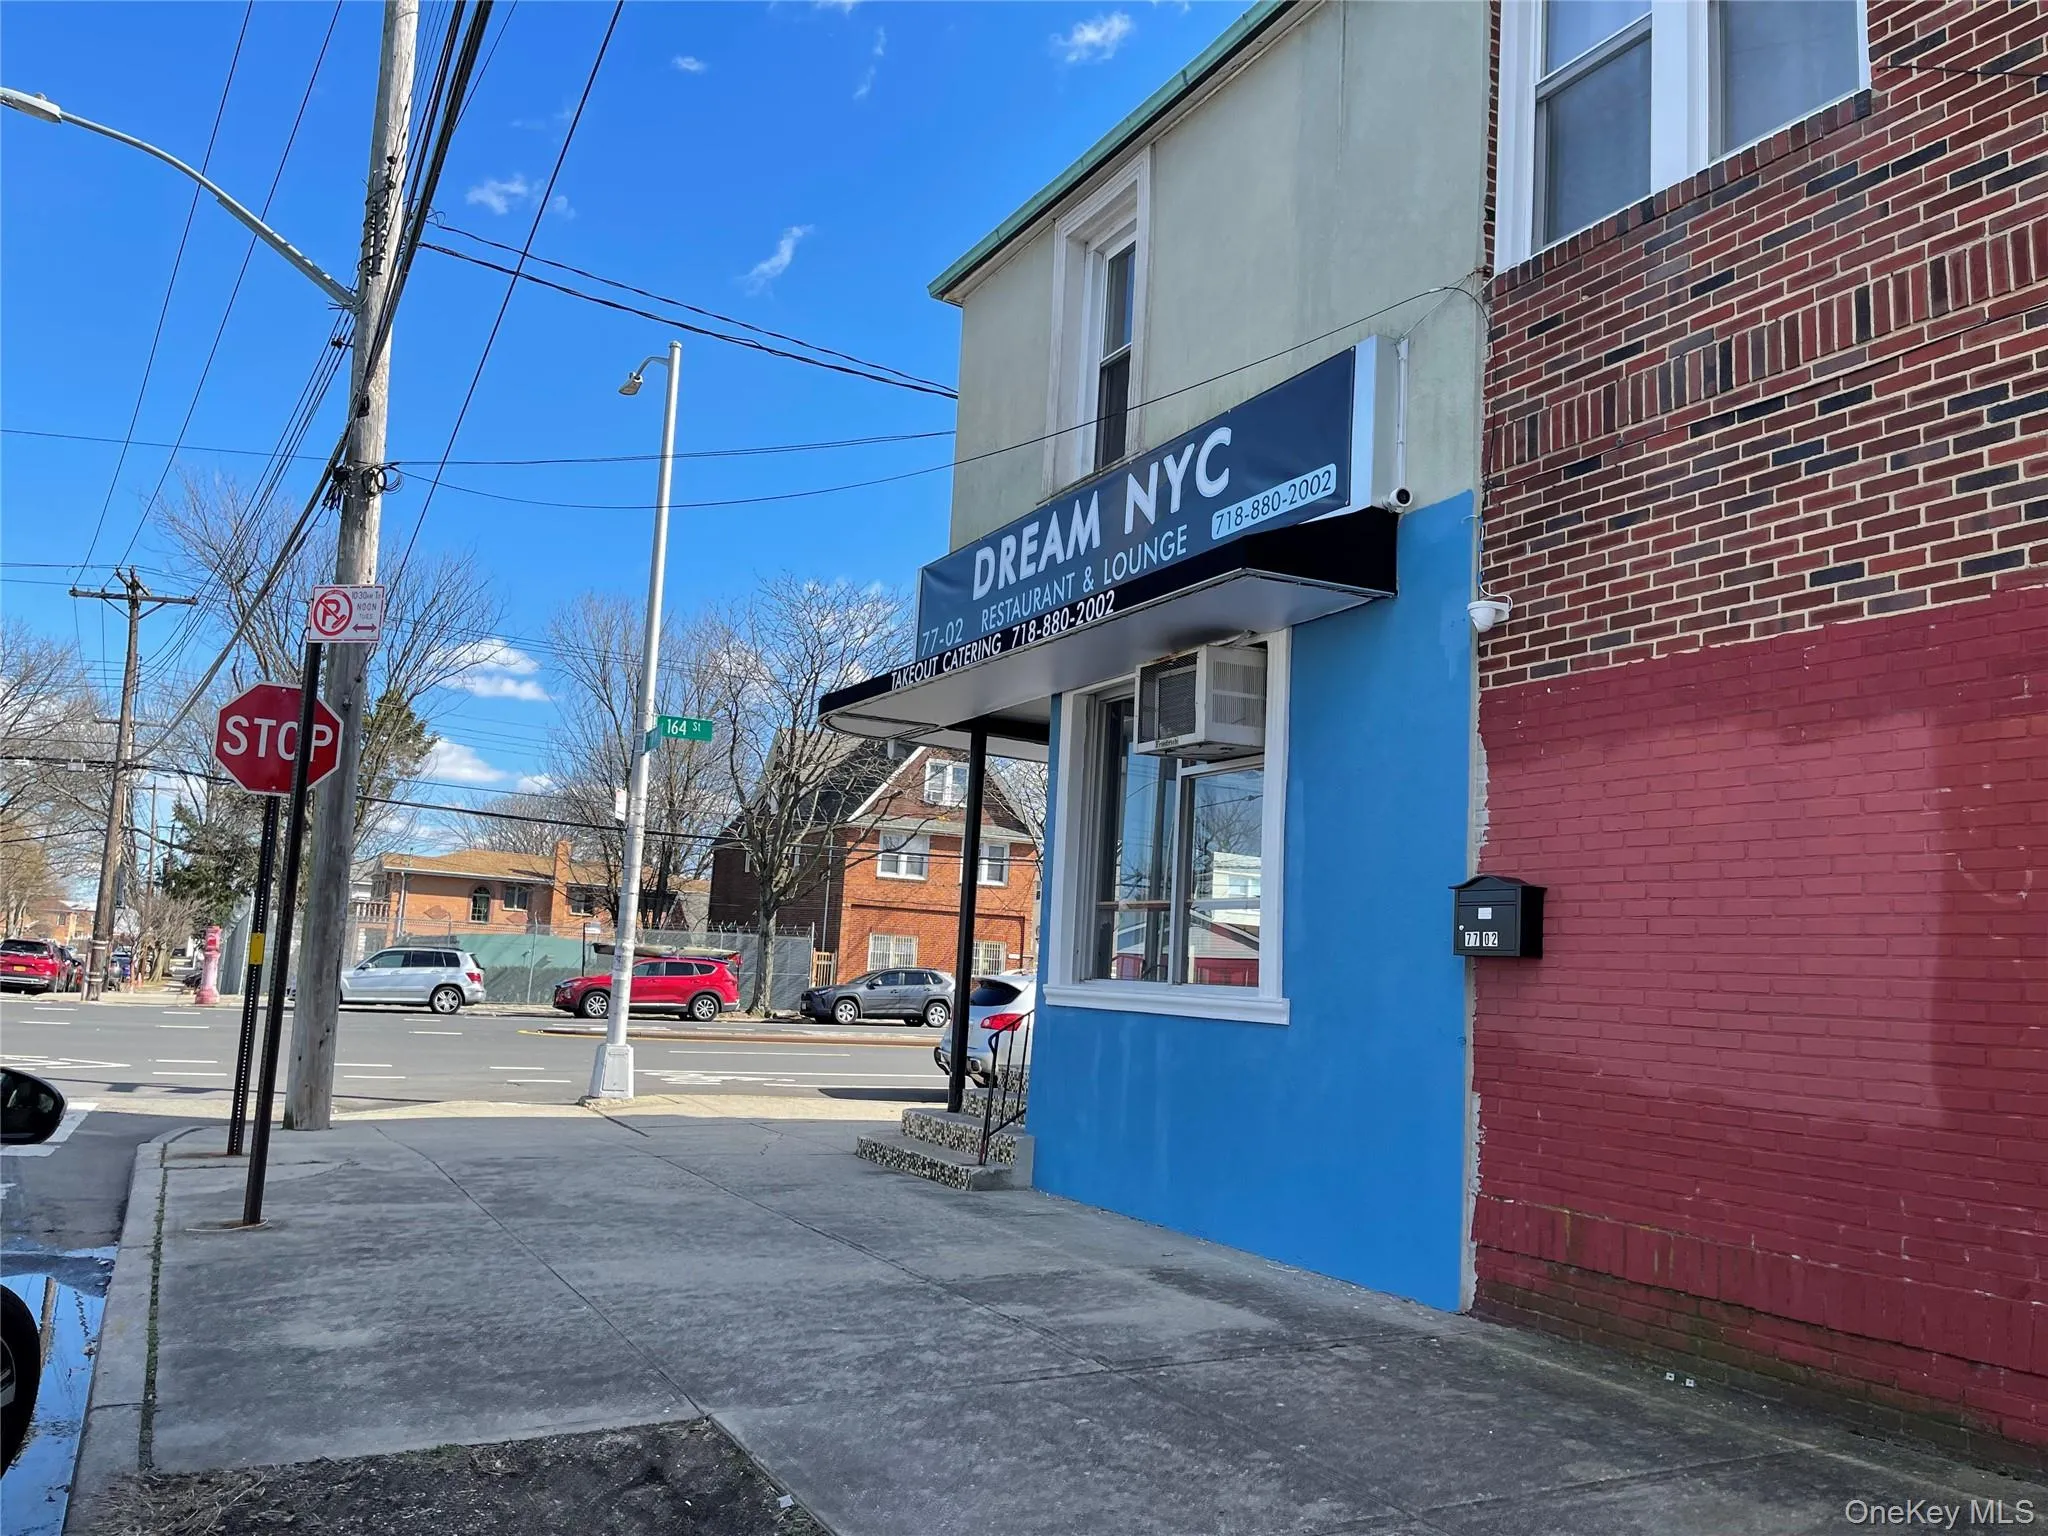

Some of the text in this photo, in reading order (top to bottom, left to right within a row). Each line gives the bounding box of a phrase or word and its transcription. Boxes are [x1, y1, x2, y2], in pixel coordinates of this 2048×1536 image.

[972, 426, 1232, 601] DREAM NYC
[1215, 470, 1332, 535] 718-880-2002
[980, 524, 1188, 633] RESTAURANT & LOUNGE
[891, 590, 1115, 690] TAKEOUT CATERING 718-880-2002
[921, 618, 964, 657] 77-02
[667, 718, 687, 735] 164
[1466, 933, 1497, 945] 77 02
